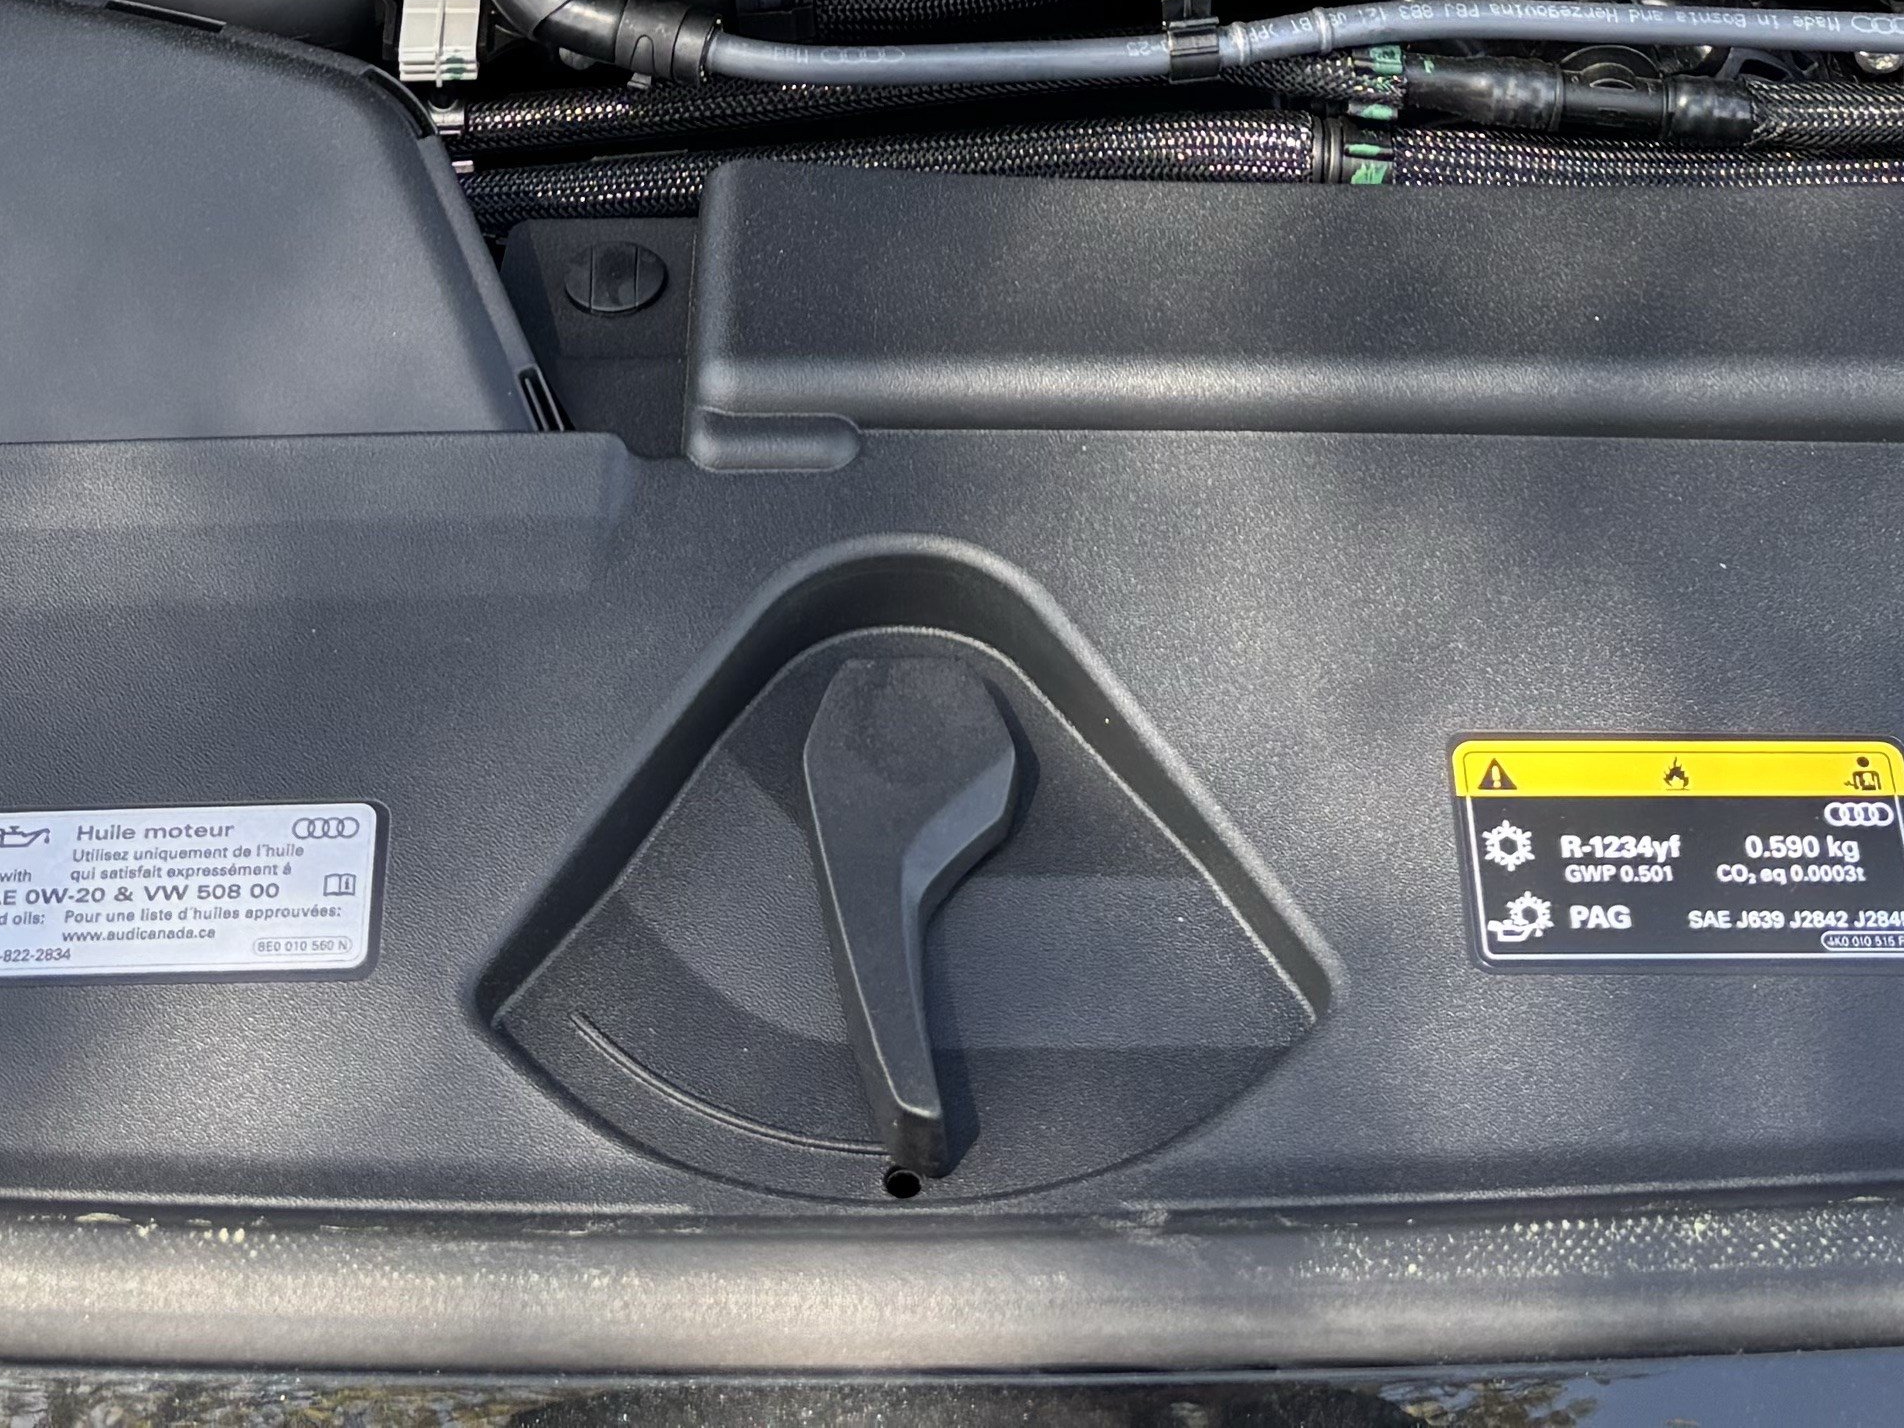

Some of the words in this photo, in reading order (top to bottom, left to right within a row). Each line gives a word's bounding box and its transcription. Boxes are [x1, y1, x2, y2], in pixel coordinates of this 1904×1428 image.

[1489, 3, 1619, 23] Herzegovina
[1629, 9, 1663, 23] and
[1675, 10, 1747, 29] Bosnia
[1758, 14, 1779, 31] in
[1792, 15, 1841, 33] Made
[76, 824, 136, 841] Huile
[144, 823, 235, 840] moteur
[73, 847, 129, 863] Utilisez
[133, 846, 228, 863] uniquement
[232, 846, 252, 858] de
[1560, 834, 1682, 863] R-1234yf
[1745, 834, 1821, 859] 0.590
[1826, 834, 1860, 863] kg
[0, 870, 33, 883] with
[70, 867, 95, 882] qui
[100, 864, 163, 880] satisfait
[166, 863, 279, 880] expressément
[1564, 865, 1617, 883] GWP
[1620, 865, 1674, 883] 0.501
[1760, 867, 1788, 886] eq
[1789, 864, 1866, 883] 0.0003t
[25, 887, 106, 904] 0W-20
[113, 886, 134, 902] &
[144, 884, 189, 902] VW
[197, 883, 241, 900] 508
[249, 882, 280, 899] 00
[12, 912, 46, 925] oils:
[64, 909, 101, 923] Pour
[106, 911, 135, 922] une
[140, 907, 173, 922] liste
[1569, 904, 1632, 930] PAG
[1687, 910, 1733, 929] SAE
[1736, 910, 1785, 929] J639
[1789, 910, 1849, 928] J2842
[62, 926, 216, 942] www.audicanada.ca
